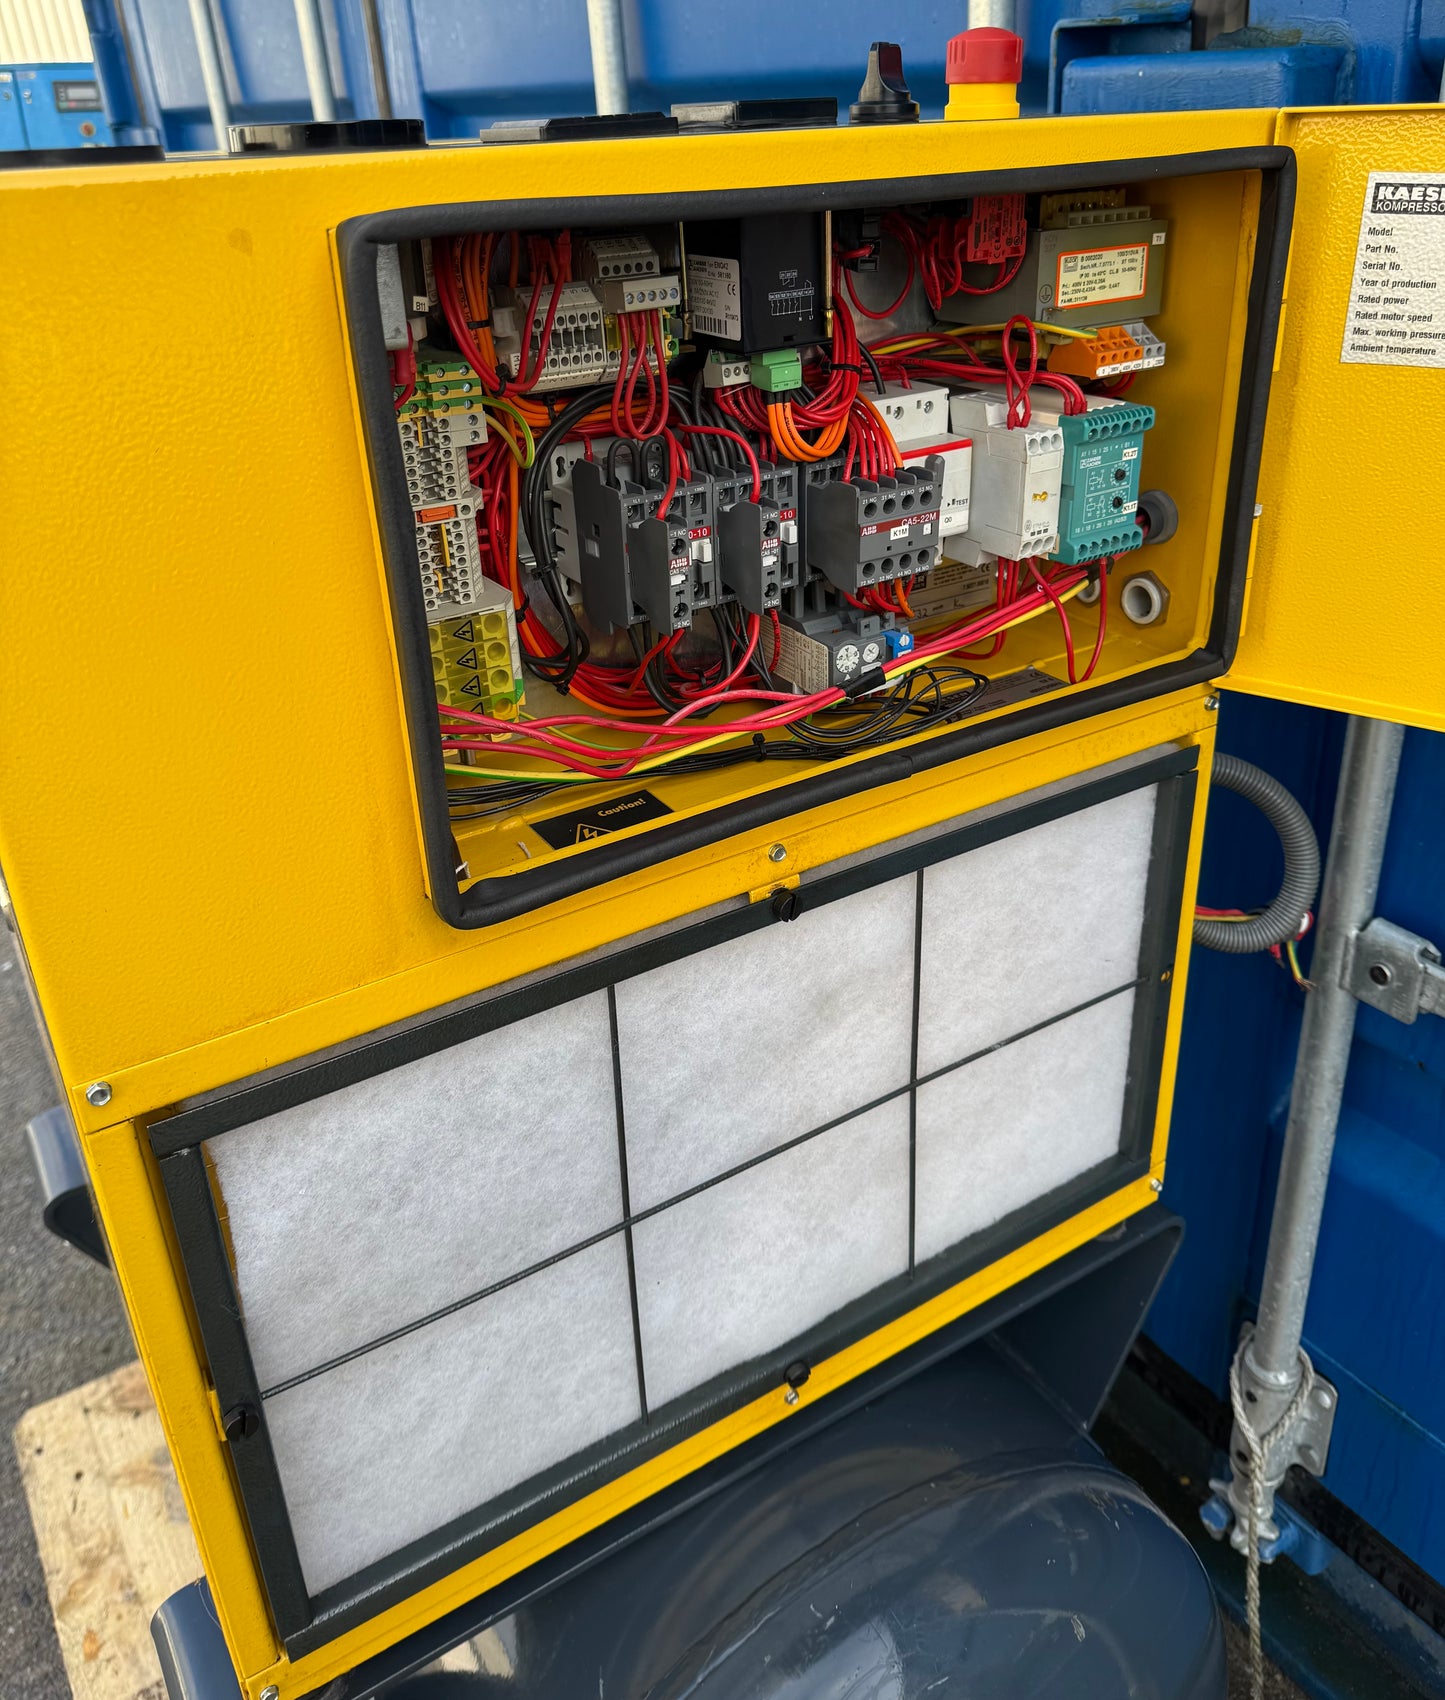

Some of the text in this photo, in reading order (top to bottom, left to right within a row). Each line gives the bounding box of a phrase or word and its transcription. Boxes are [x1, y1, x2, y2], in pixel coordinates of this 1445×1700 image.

[1368, 226, 1394, 236] Model
[1365, 244, 1399, 254] Part No.
[1362, 260, 1404, 271] Serial No.
[1360, 278, 1437, 290] Year of production
[1357, 294, 1410, 306] Rated power
[1354, 310, 1433, 324] Rated motor speed
[1352, 327, 1445, 340] Max. working pressure
[1350, 343, 1437, 356] Ambient temperature
[956, 498, 968, 506] TEST
[862, 525, 877, 536] ABB
[762, 538, 778, 550] ABB
[670, 557, 688, 570] ABB
[597, 798, 646, 817] Caution!
